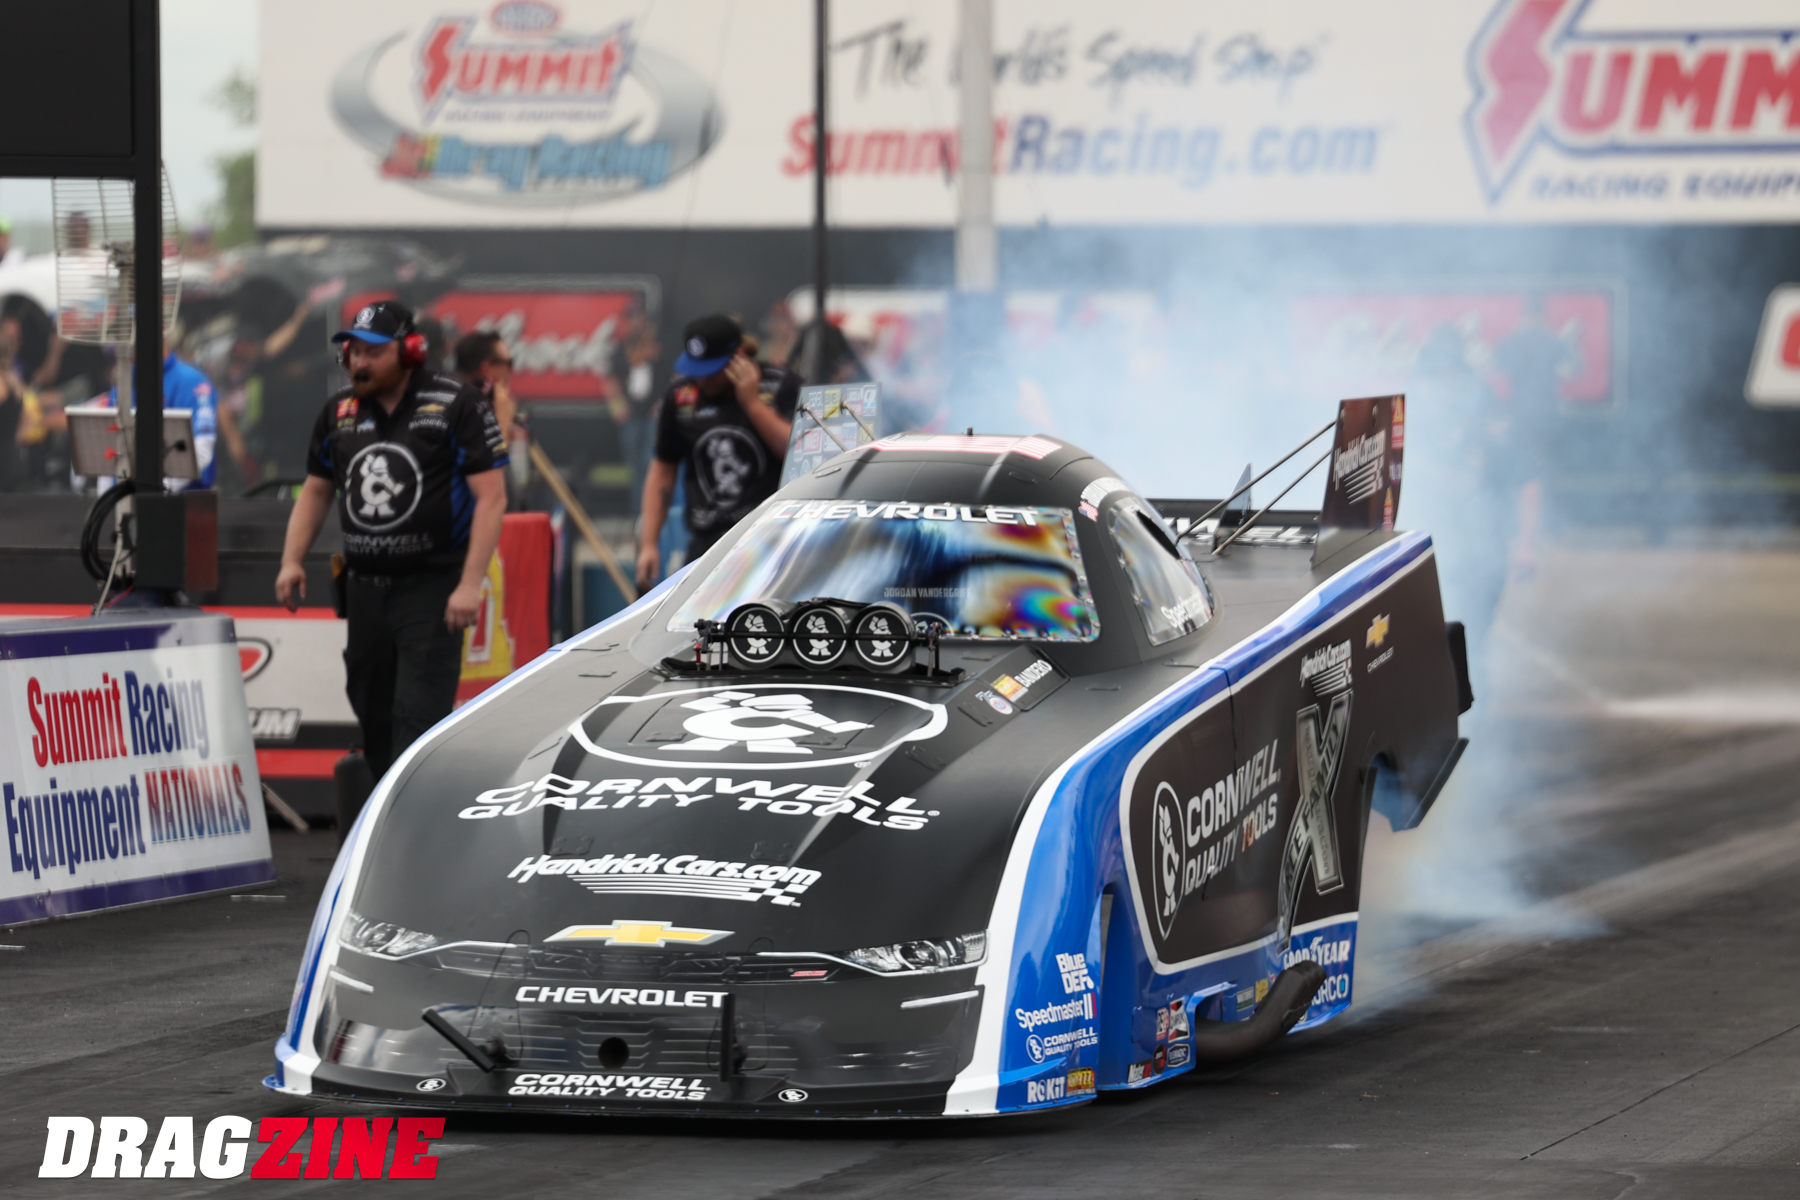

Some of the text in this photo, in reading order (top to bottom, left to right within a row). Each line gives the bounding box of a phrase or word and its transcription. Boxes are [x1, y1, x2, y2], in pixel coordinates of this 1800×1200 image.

[420, 22, 626, 104] SUMMIT
[828, 18, 1320, 108] The rld's Speed Shop
[781, 110, 1379, 190] SummtRacing.com
[1531, 171, 1668, 199] RACING
[773, 503, 1038, 526] CHEVROLET
[884, 587, 916, 598] JORDAN
[27, 668, 210, 768] Summit Racing
[475, 773, 927, 815] CORNWELL
[1186, 738, 1279, 849] CORNWELL
[3, 762, 251, 880] Equipment NATIONALS
[458, 794, 929, 831] QUALITY TOOLS
[1184, 823, 1241, 897] QUALITY
[1241, 793, 1279, 853] TOOLS
[1055, 952, 1086, 974] Blue
[1061, 968, 1089, 994] DEF
[515, 986, 729, 1008] CHEVROLET
[1015, 999, 1084, 1032] Speedmaster
[1044, 1026, 1097, 1048] CORNWELL
[1044, 1035, 1099, 1056] QUALITY TOOLS
[507, 1086, 708, 1101] QUALITY TOOLS
[514, 1073, 706, 1091] CORNWELL
